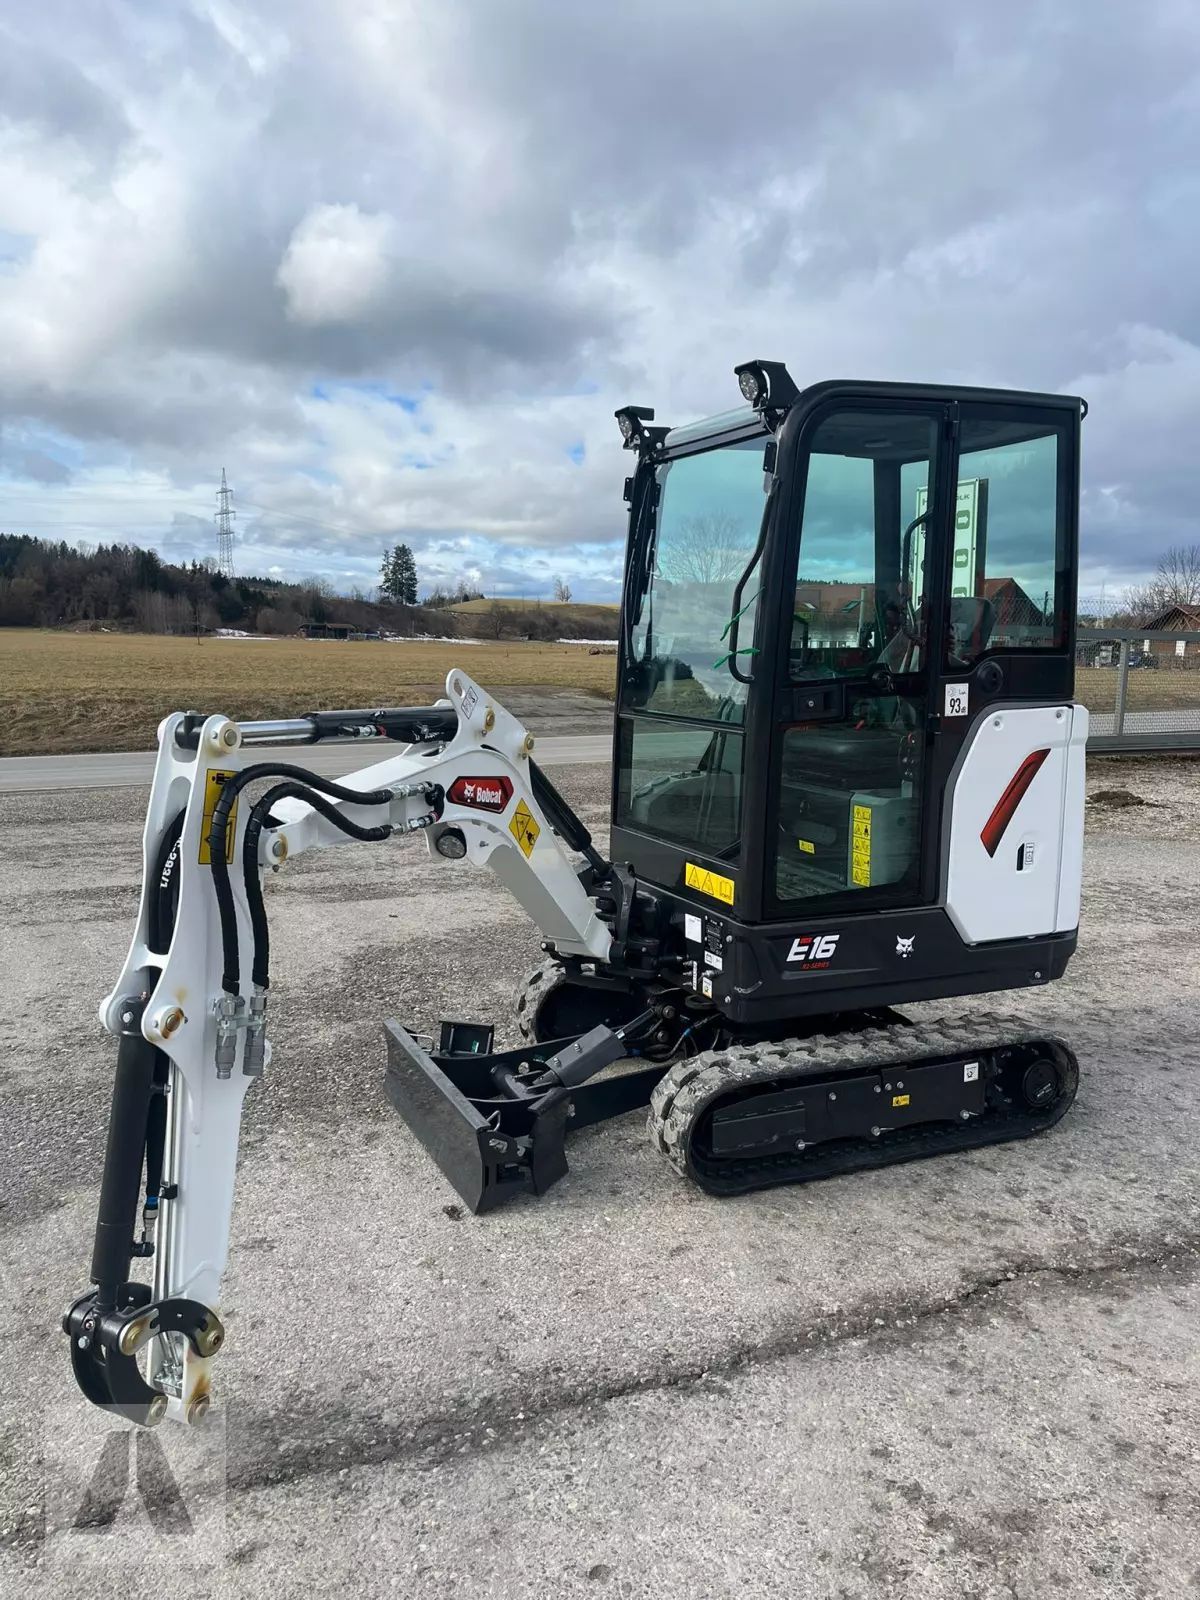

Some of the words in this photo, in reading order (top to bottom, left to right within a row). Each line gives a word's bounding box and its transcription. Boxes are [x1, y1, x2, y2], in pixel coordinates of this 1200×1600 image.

[950, 698, 961, 714] 93
[476, 786, 502, 804] Bobcat
[786, 934, 840, 962] E16
